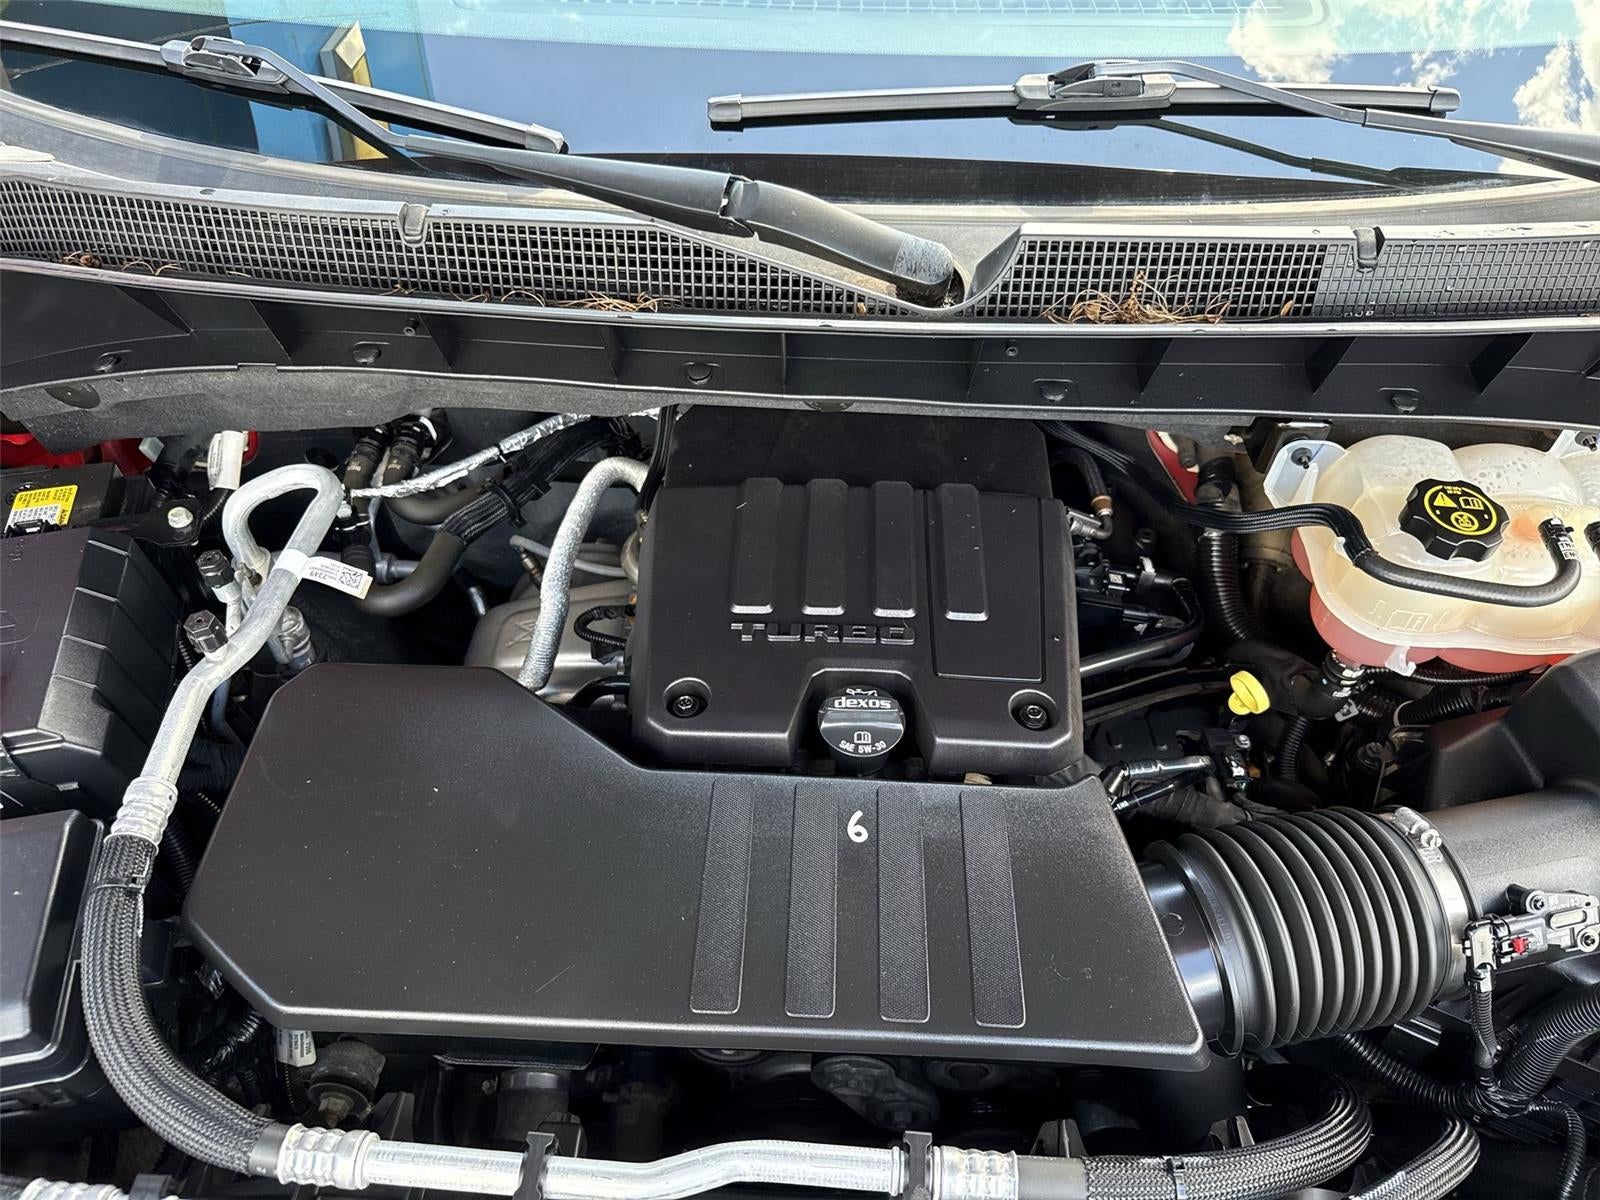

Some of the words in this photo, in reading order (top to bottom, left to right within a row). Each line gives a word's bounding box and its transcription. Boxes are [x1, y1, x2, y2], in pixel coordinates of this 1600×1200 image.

[731, 622, 915, 646] TURBO
[834, 696, 892, 709] dexos
[838, 740, 856, 752] SAE
[857, 740, 887, 754] 5W-30
[846, 810, 869, 843] 6
